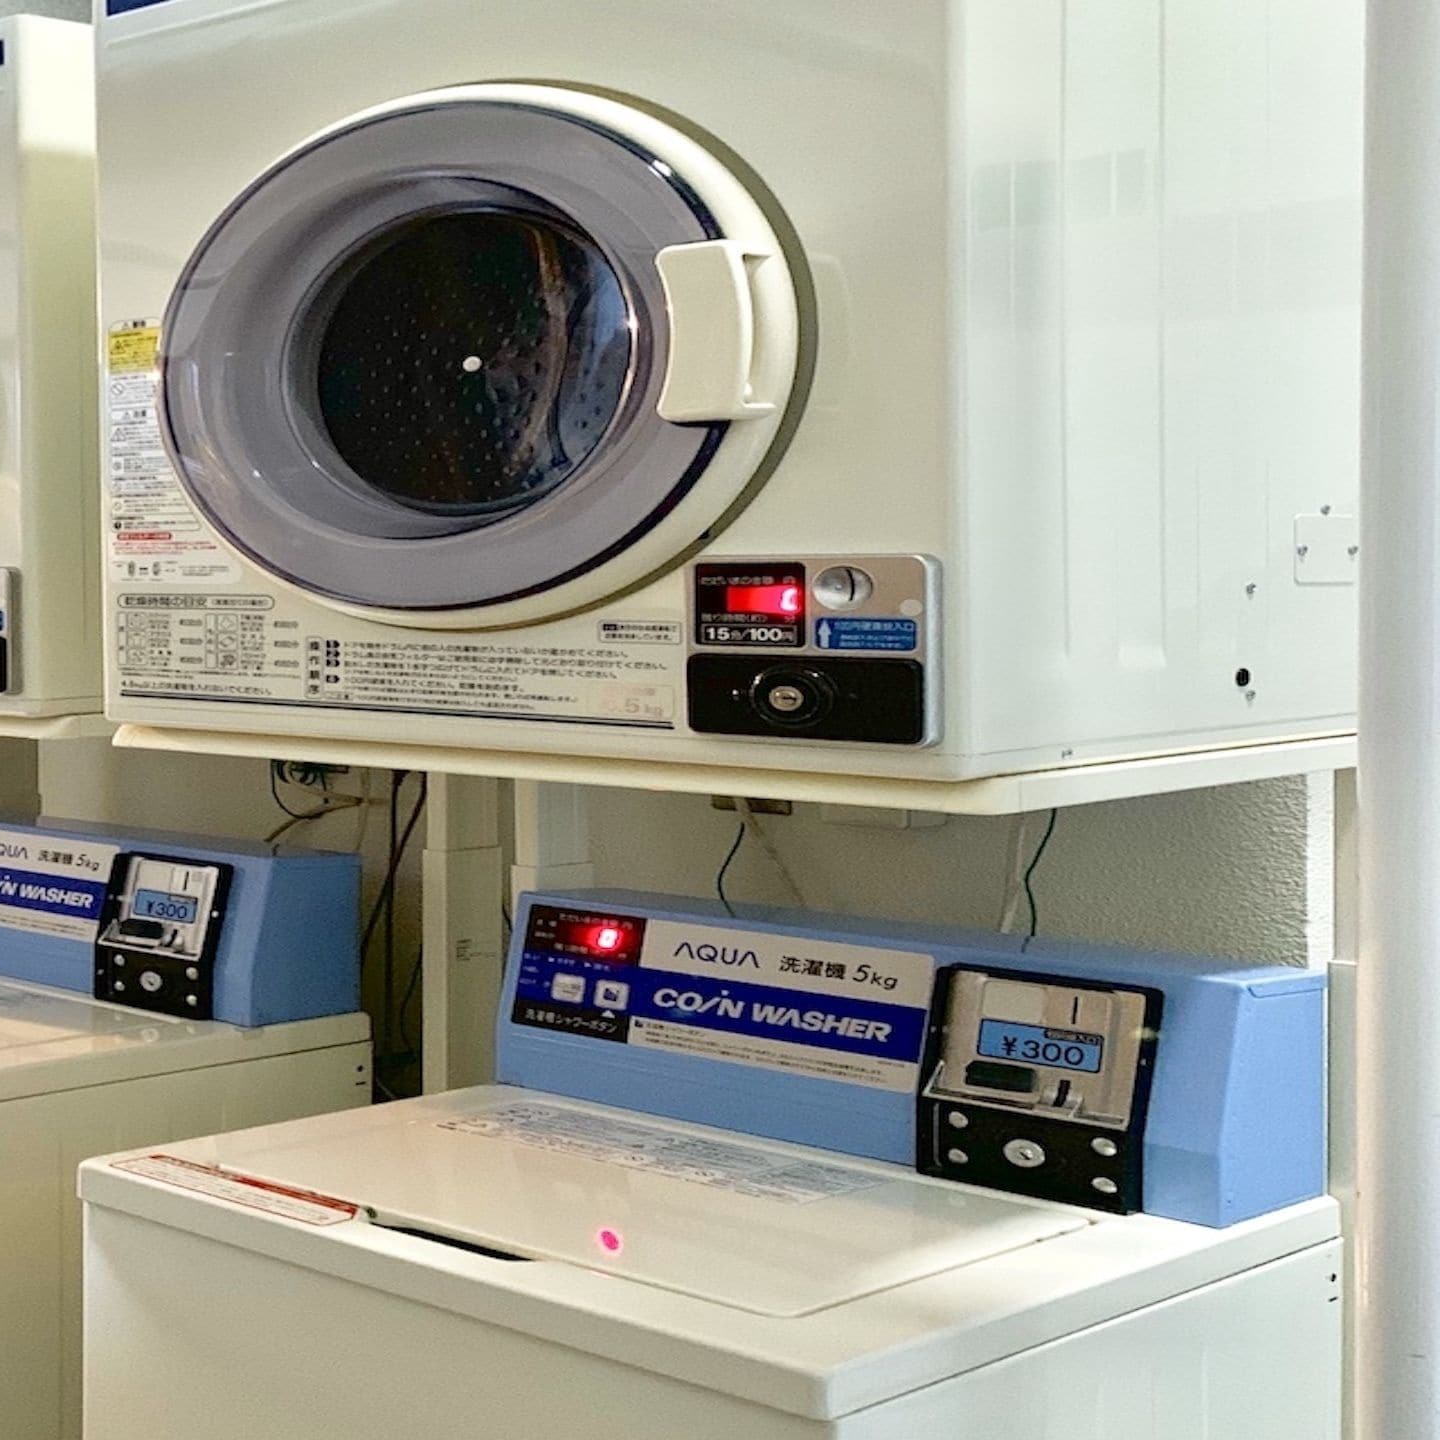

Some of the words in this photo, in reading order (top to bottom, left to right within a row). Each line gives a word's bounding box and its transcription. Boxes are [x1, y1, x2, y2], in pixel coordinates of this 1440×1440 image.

[19, 883, 94, 909] WASHER
[673, 941, 761, 969] AQUA
[779, 954, 846, 981] 洗濯機
[852, 963, 898, 991] 5kg
[751, 1001, 892, 1043] WASHER
[1001, 1035, 1085, 1067] ¥300
